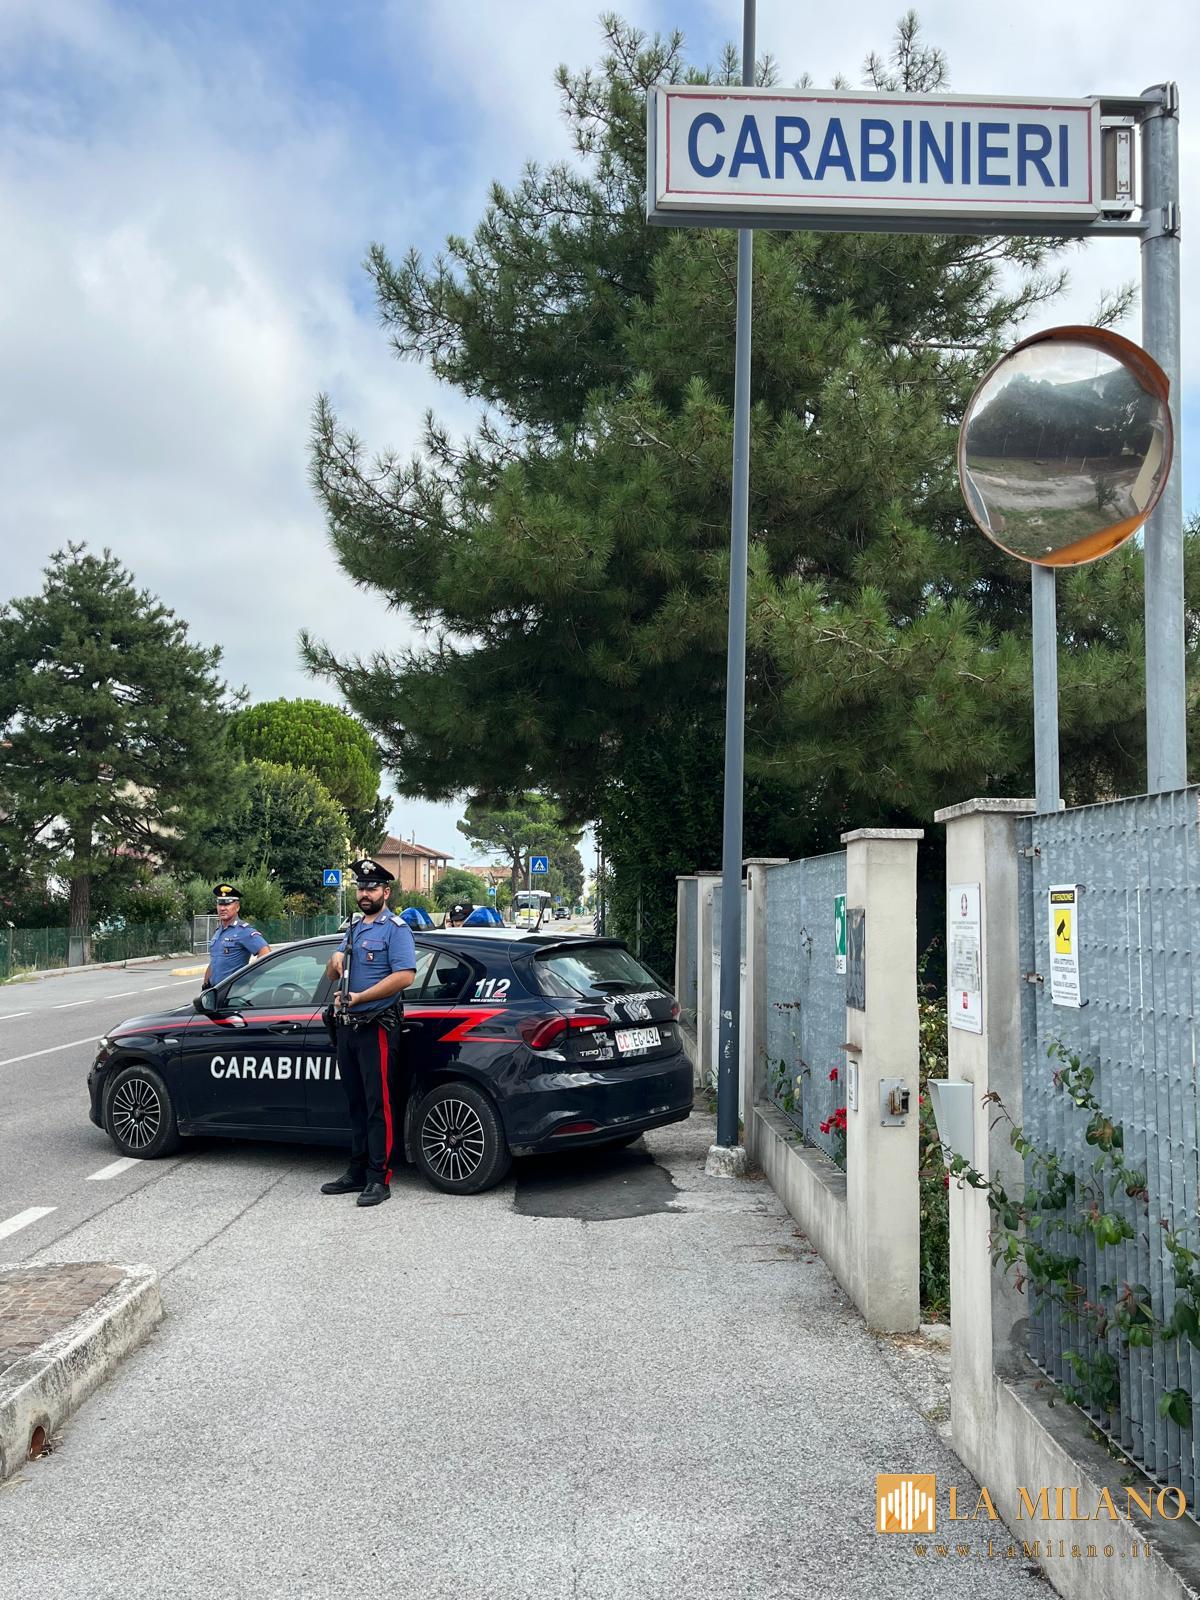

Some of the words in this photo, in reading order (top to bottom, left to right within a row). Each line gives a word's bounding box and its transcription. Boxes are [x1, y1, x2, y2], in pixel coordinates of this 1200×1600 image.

[687, 112, 1069, 188] CARABINIERI
[474, 978, 511, 998] 112
[602, 991, 667, 1004] CARABINIERI
[617, 1033, 630, 1050] CC
[580, 1049, 599, 1057] TIPO
